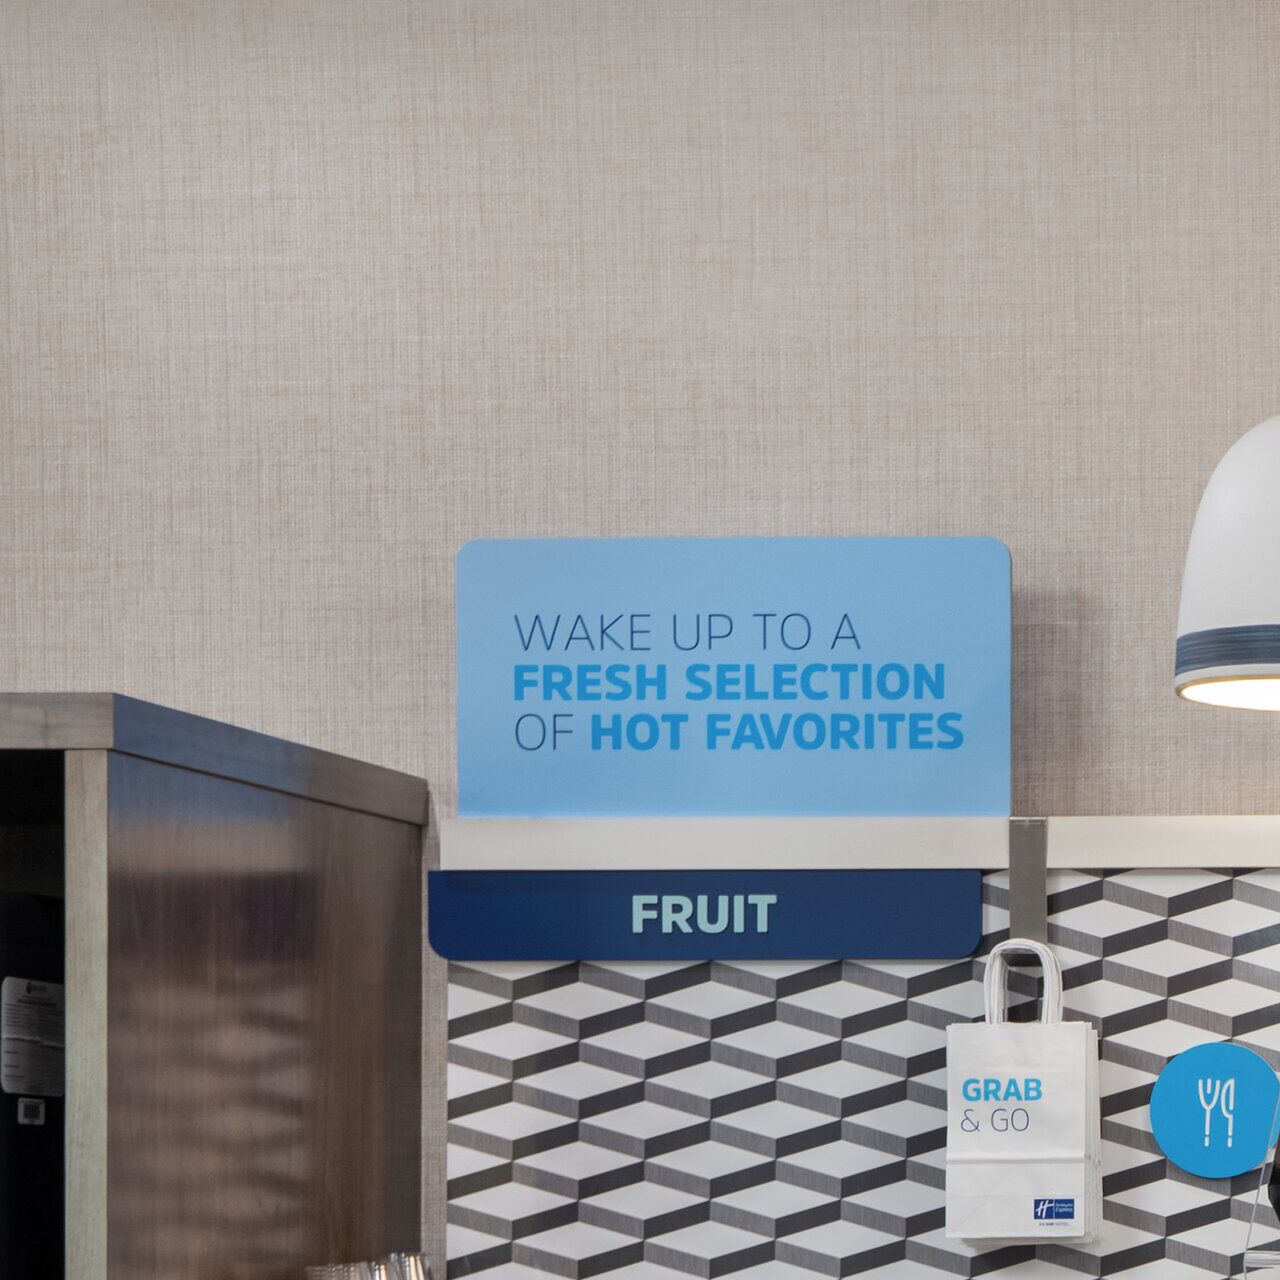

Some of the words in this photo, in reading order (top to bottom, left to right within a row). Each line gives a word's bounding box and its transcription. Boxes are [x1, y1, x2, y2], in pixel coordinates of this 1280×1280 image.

[513, 612, 651, 652] WAKE
[672, 612, 734, 652] UP
[752, 612, 812, 651] TO
[830, 612, 862, 651] A
[513, 663, 667, 702] FRESH
[685, 662, 945, 702] SELECTION
[514, 713, 574, 752] OF
[590, 712, 689, 752] HOT
[706, 711, 965, 752] FAVORITES
[631, 893, 778, 935] FRUIT
[962, 1077, 1043, 1102] GRAB
[960, 1108, 981, 1133] &
[990, 1107, 1030, 1133] GO
